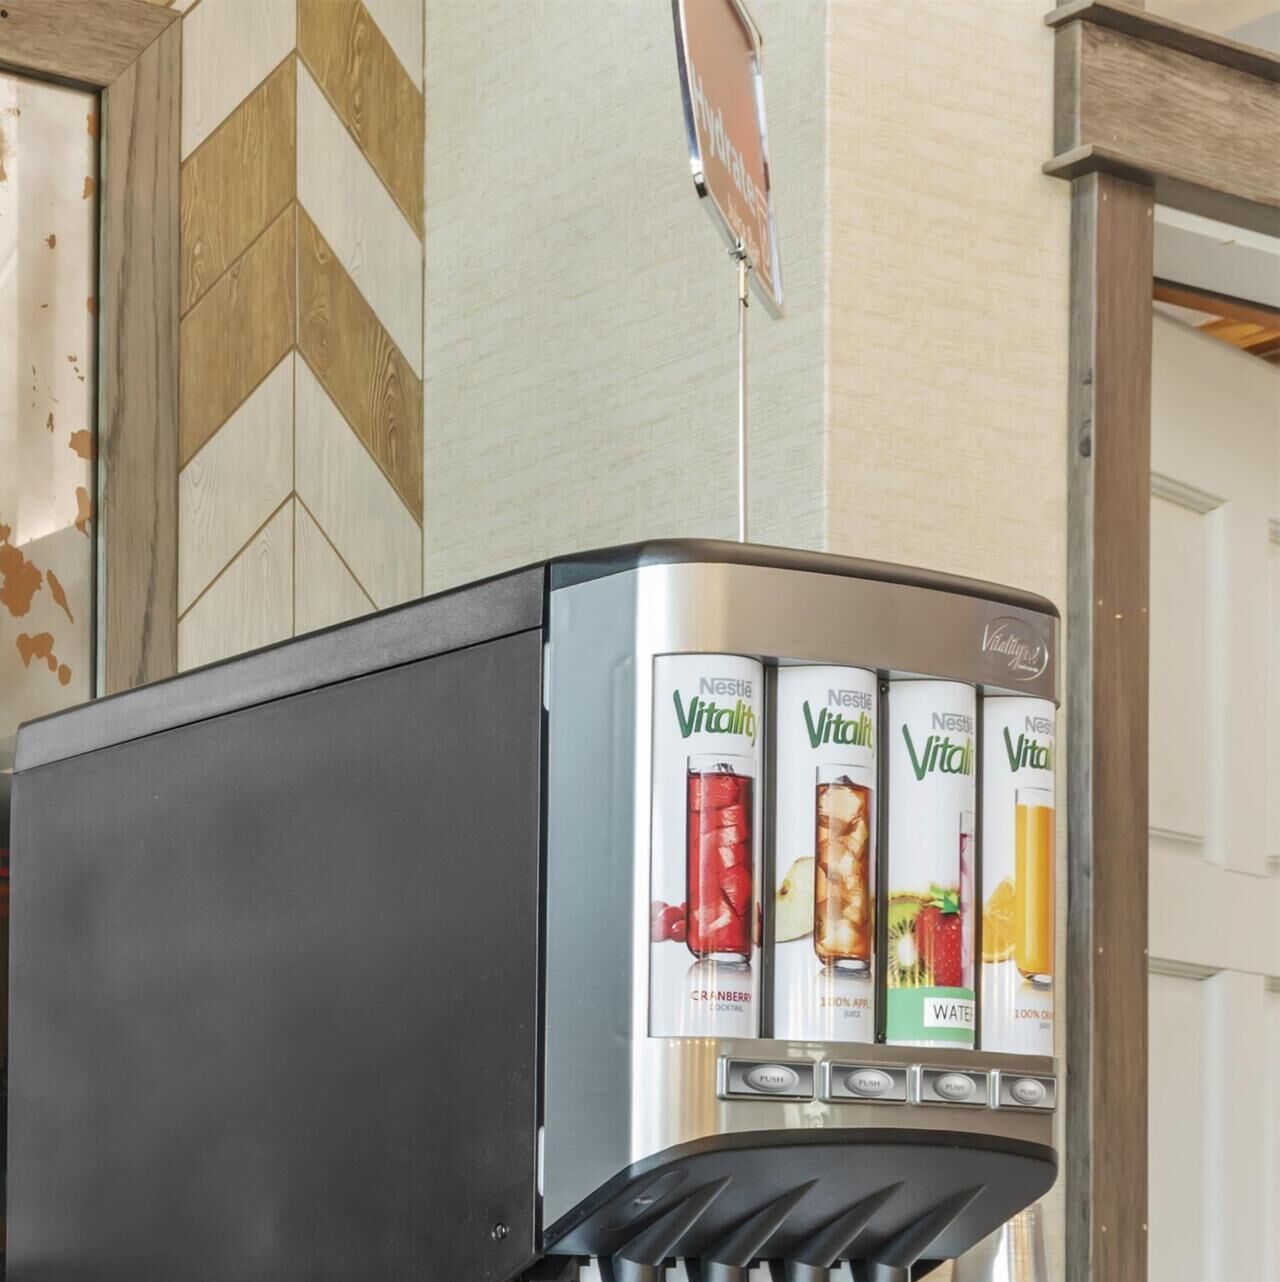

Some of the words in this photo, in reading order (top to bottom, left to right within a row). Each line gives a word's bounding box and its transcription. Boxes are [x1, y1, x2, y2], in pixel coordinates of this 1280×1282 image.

[803, 700, 874, 749] Vitalit
[902, 724, 973, 781] Vital
[1003, 726, 1053, 772] Vital
[852, 998, 871, 1009] APPL
[759, 1075, 784, 1084] PUSH
[858, 1079, 880, 1088] PUSH
